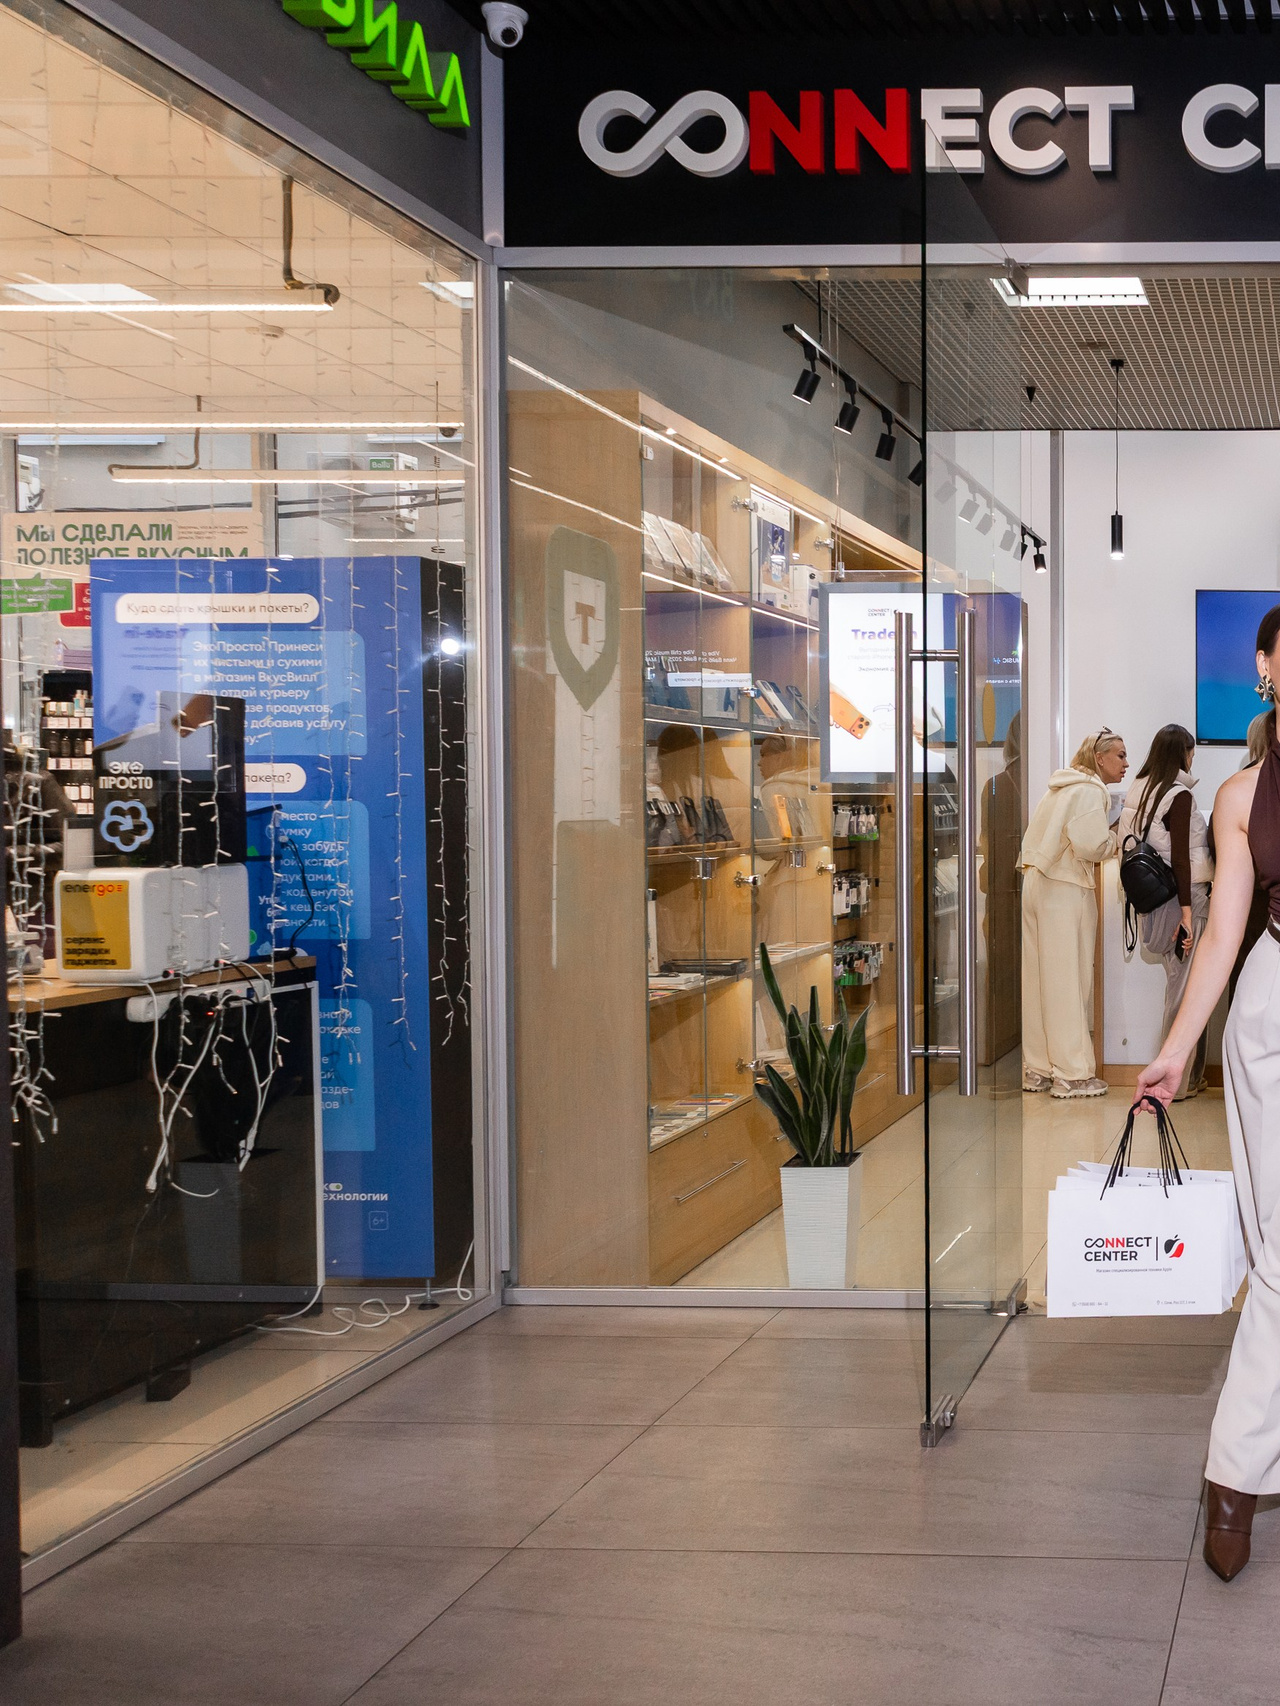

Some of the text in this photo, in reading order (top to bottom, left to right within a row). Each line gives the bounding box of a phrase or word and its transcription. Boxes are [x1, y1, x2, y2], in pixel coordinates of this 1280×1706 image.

[578, 85, 1135, 178] CONNECT
[126, 602, 310, 616] Куда сдать крышки и пакеты?
[269, 642, 323, 652] Принеси
[194, 659, 208, 667] их
[277, 658, 323, 668] сухими
[258, 672, 317, 684] ВкусВилл
[260, 688, 310, 700] курьеру
[99, 777, 153, 790] ПРОСТО
[65, 937, 106, 945] сервис
[65, 948, 111, 957] зарядки
[65, 959, 118, 967] гаджетов
[323, 1192, 388, 1201] ехнологии
[1084, 1236, 1153, 1249] CONNECT
[1084, 1250, 1138, 1262] CENTER
